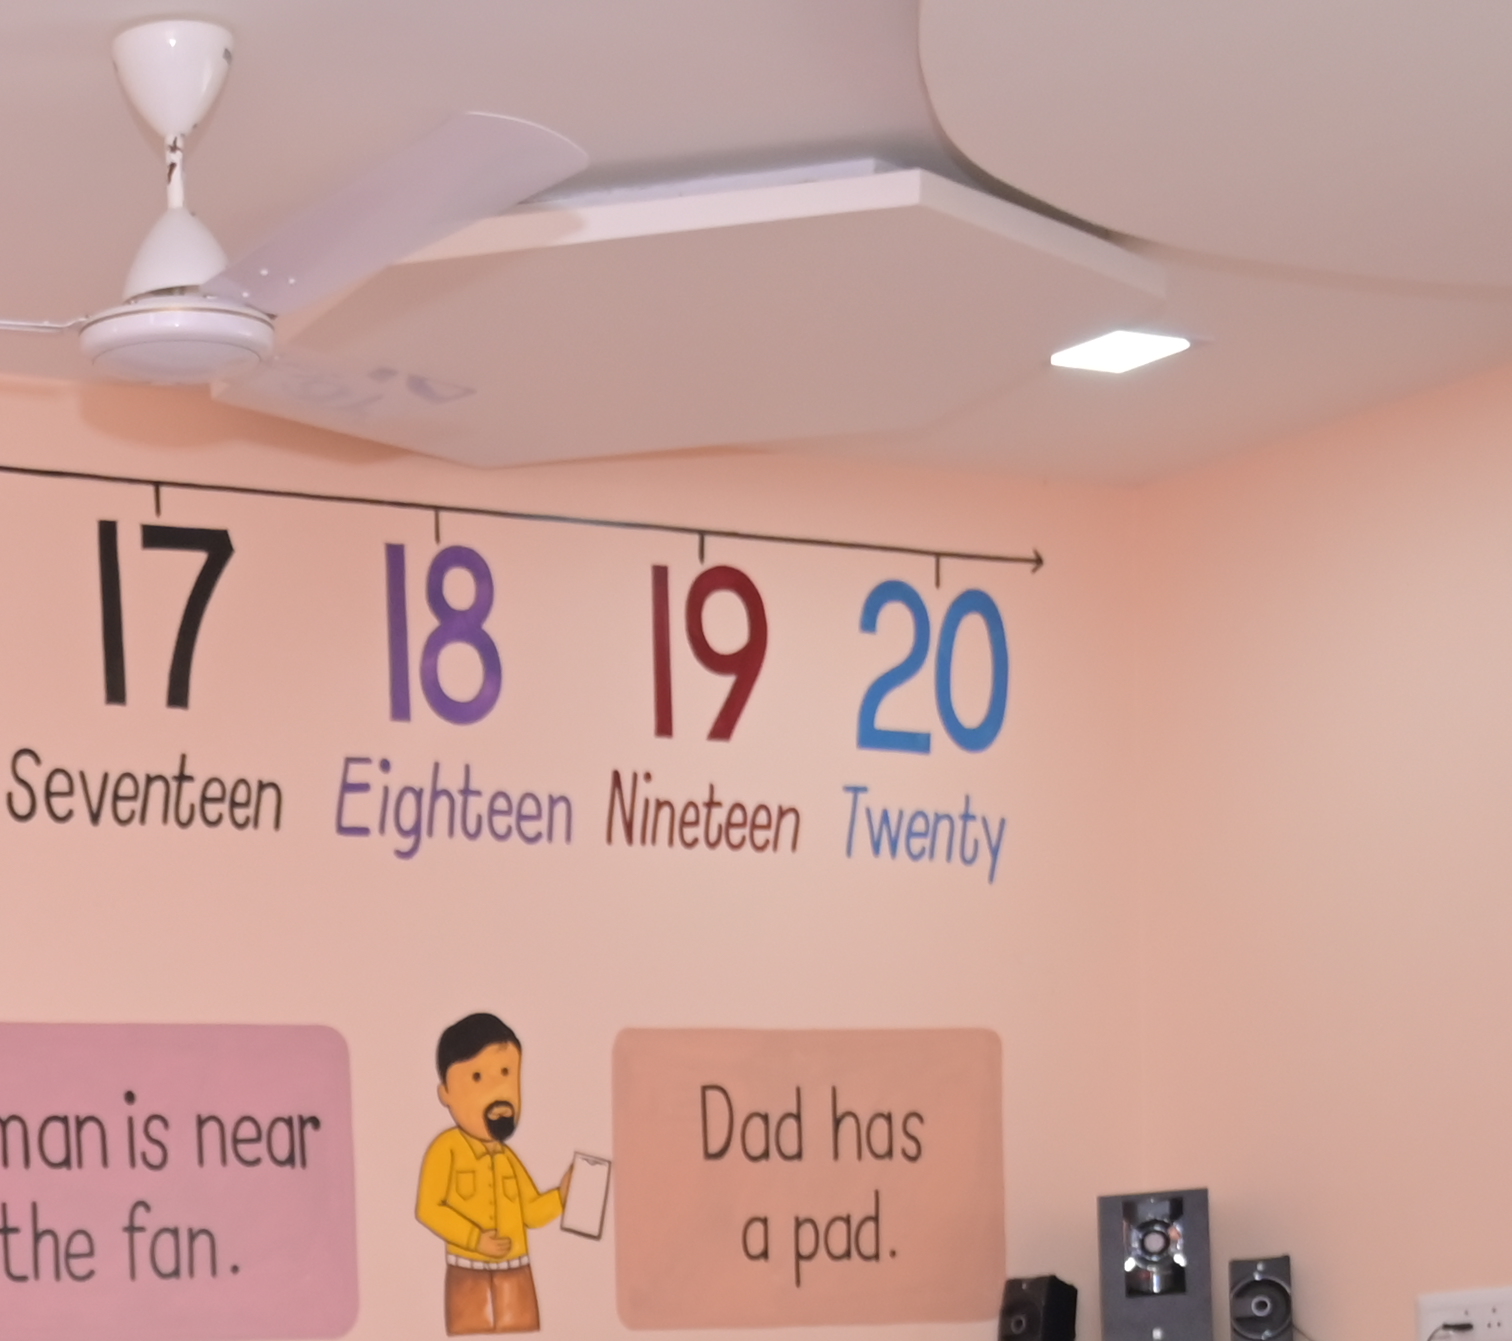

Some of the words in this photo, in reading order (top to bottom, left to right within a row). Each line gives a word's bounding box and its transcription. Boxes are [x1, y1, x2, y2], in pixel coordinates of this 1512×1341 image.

[98, 520, 234, 709] 17
[386, 543, 502, 724] 18
[652, 565, 768, 741] 19
[858, 580, 1009, 754] 20
[7, 748, 282, 830] Seventeen
[336, 757, 572, 859] Eighteen
[606, 769, 800, 852] Nineteen
[844, 786, 1006, 883] Twenty
[124, 1090, 169, 1170] is
[197, 1114, 321, 1168] near
[701, 1084, 803, 1162] Dad
[832, 1086, 924, 1163] has
[123, 1200, 239, 1280] fan.
[742, 1217, 769, 1261] a
[794, 1190, 897, 1287] pad.
